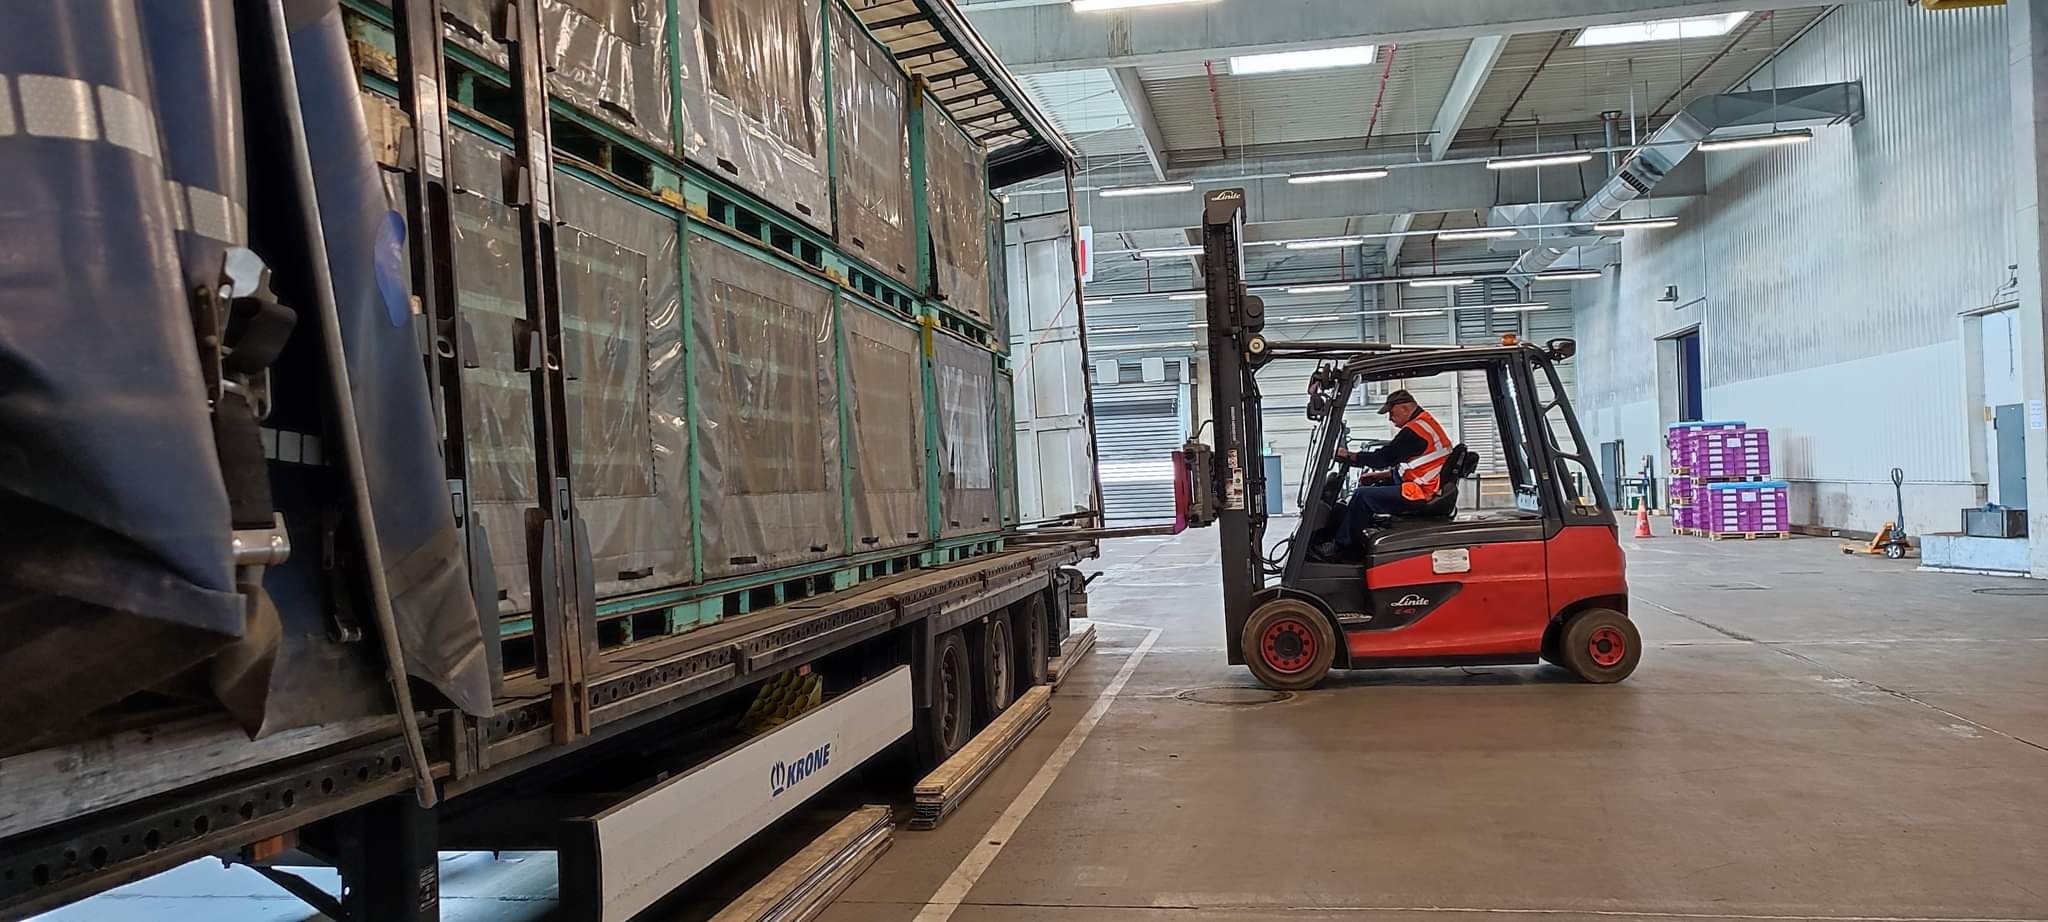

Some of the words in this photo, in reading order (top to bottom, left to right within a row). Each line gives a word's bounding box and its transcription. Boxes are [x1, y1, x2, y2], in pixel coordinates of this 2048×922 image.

[1211, 190, 1241, 201] Linde
[1390, 593, 1430, 607] Linde
[787, 743, 831, 789] KRONE
